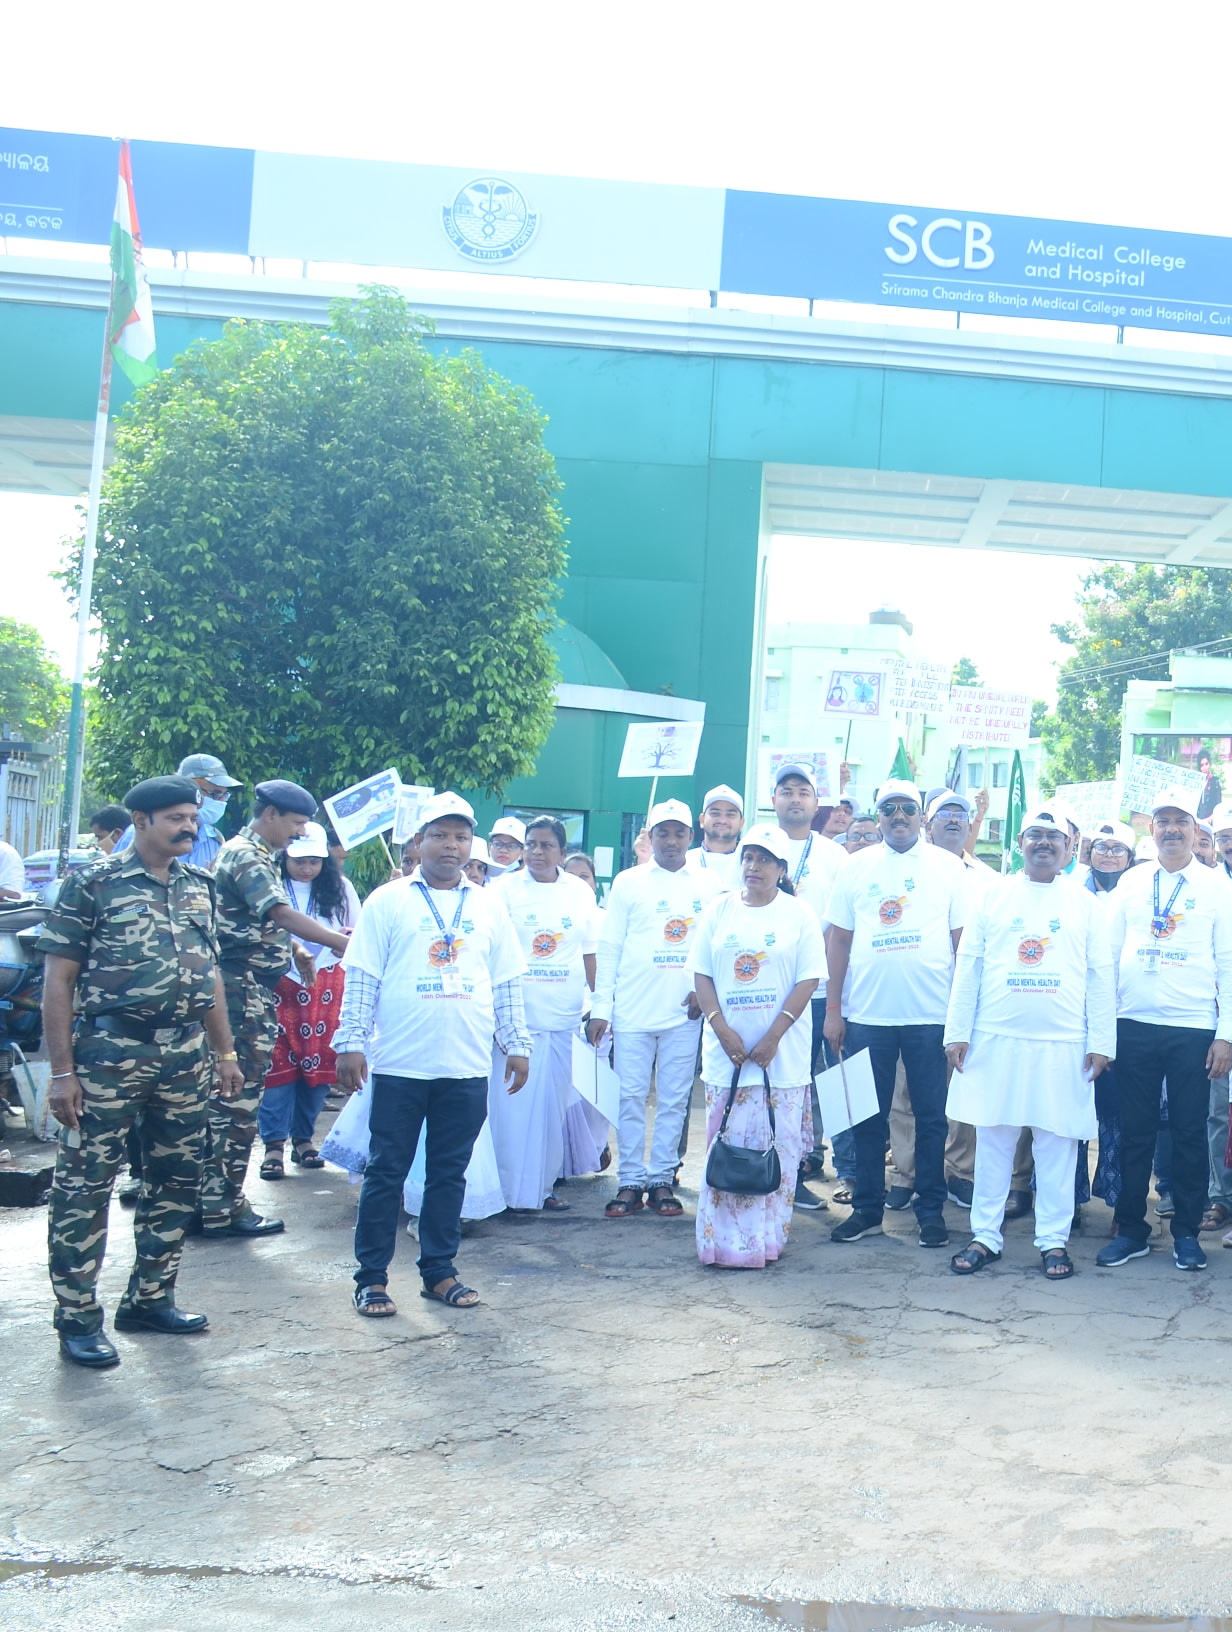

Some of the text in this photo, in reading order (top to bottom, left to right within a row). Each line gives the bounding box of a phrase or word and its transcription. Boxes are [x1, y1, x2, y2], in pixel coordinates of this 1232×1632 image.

[25, 215, 63, 230] କଟକ
[471, 249, 504, 259] ALTIUS
[884, 214, 995, 270] SCB
[1027, 240, 1187, 271] Medical College
[1025, 263, 1146, 287] and Hospital
[881, 281, 929, 298] Srirama
[932, 286, 984, 302] Chandra
[988, 291, 1028, 309] Bhanja
[1031, 296, 1079, 311] Medical
[1082, 299, 1126, 317] College
[1131, 305, 1153, 317] and
[1157, 307, 1207, 324] Hospital,
